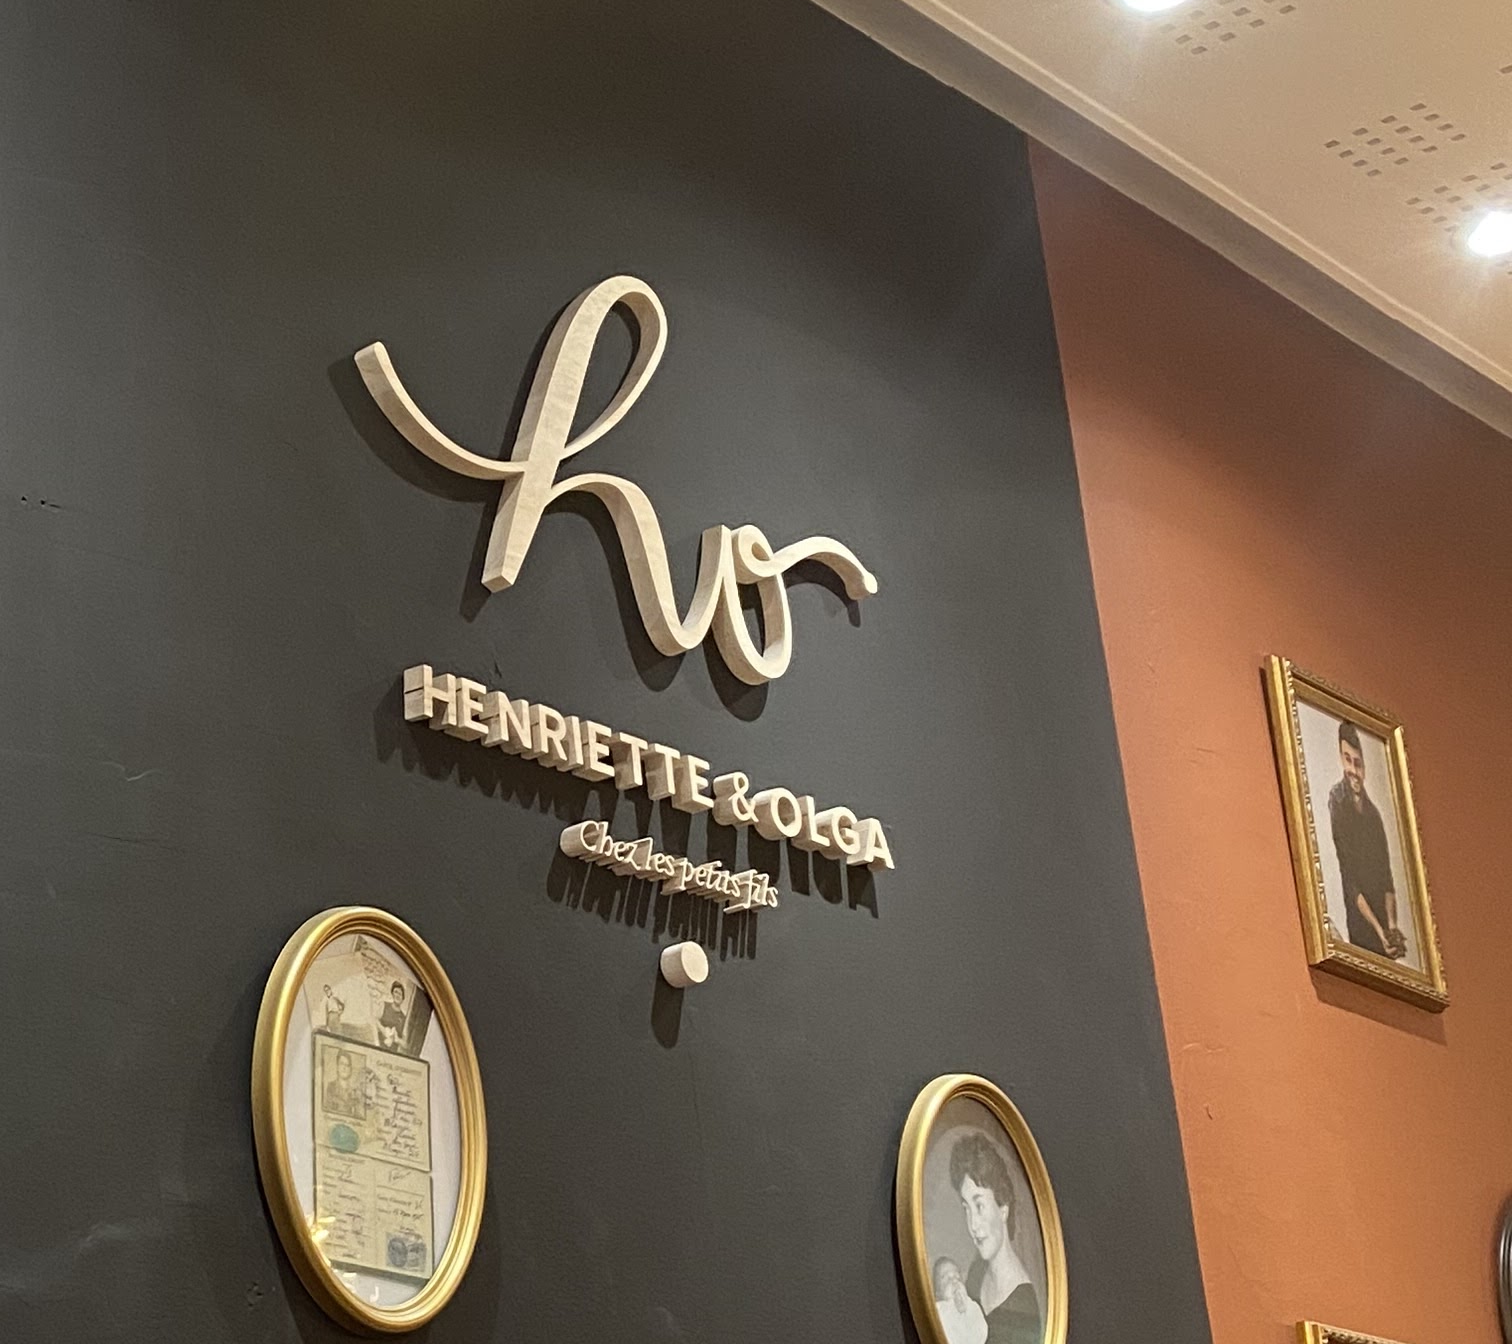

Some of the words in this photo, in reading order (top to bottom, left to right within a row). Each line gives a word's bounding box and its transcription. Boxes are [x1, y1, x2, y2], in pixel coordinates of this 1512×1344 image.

[406, 666, 715, 812] HENRIETTE
[724, 770, 759, 825] &
[764, 788, 894, 871] OLGA
[572, 820, 639, 871] Chez
[644, 837, 675, 876] les
[743, 869, 779, 908] fils
